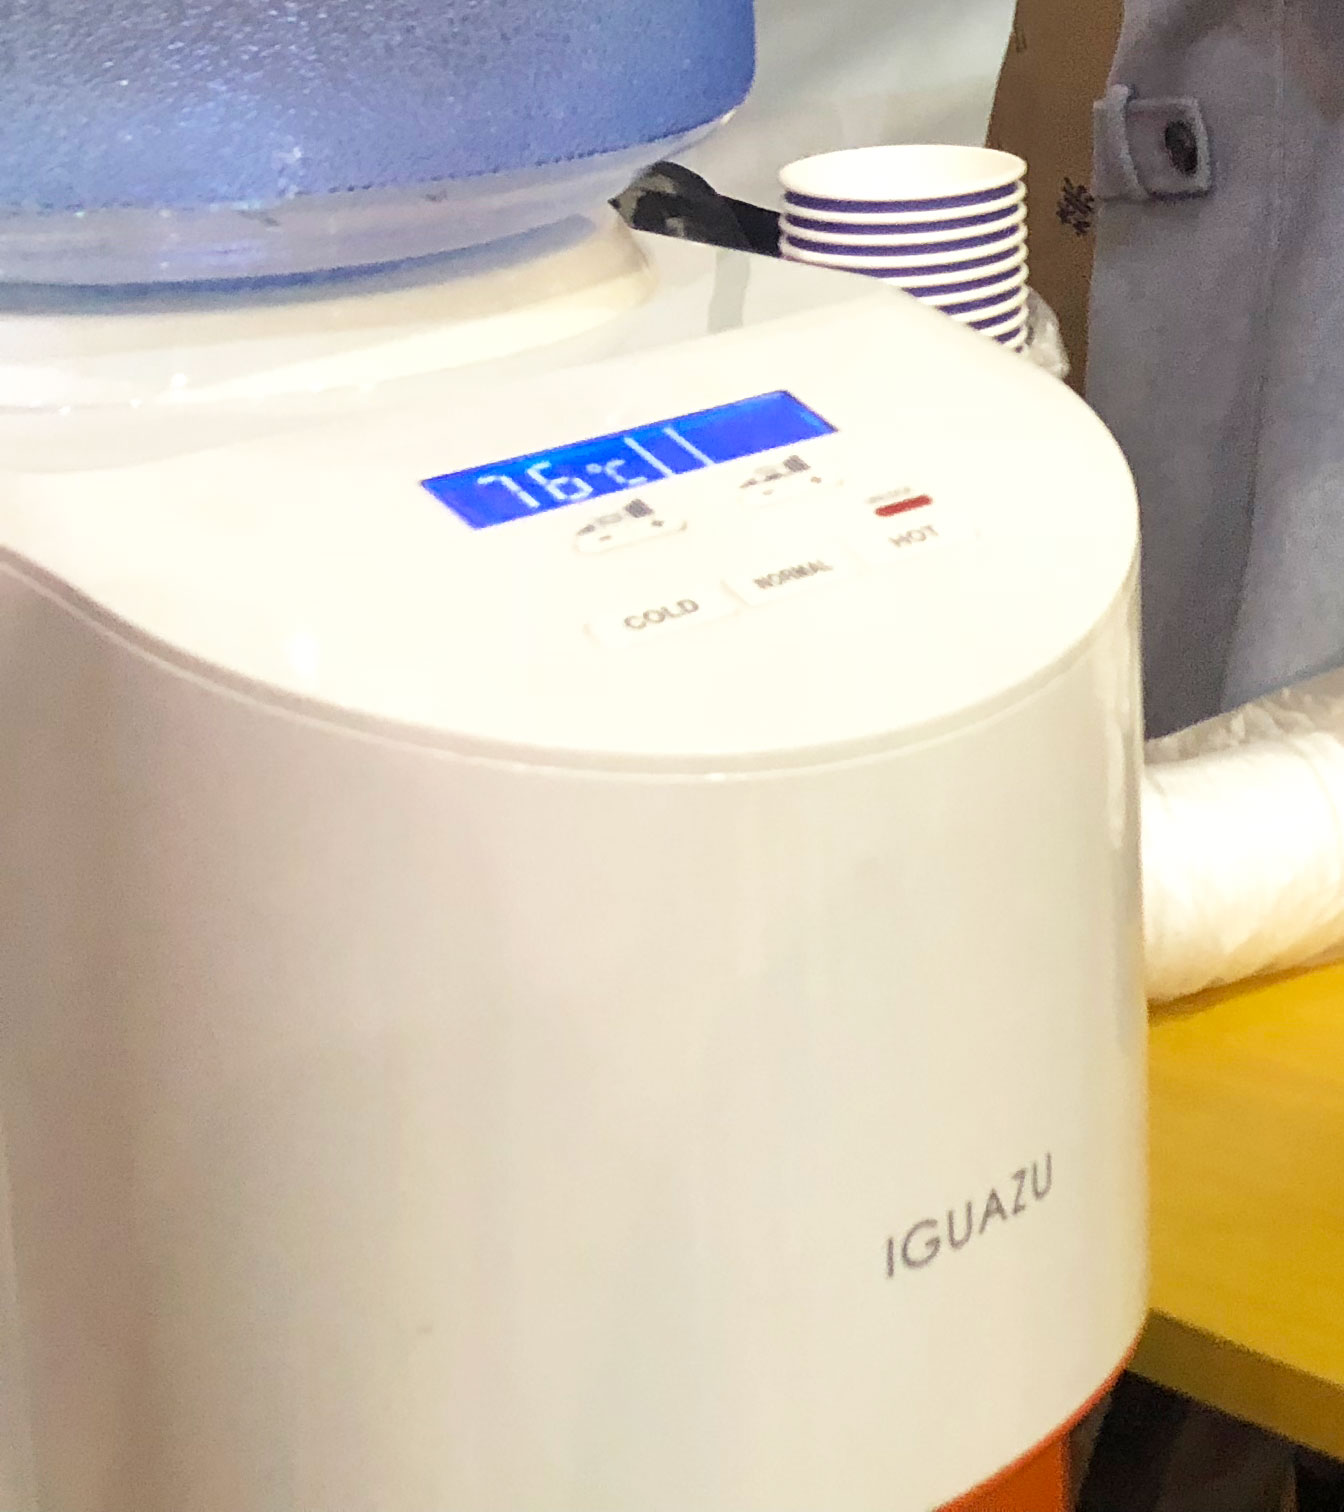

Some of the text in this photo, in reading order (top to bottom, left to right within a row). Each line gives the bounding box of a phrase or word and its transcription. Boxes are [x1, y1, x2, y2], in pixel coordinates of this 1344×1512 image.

[888, 524, 939, 548] HOT
[753, 560, 833, 589] NORMAL
[623, 599, 699, 630] COLD
[885, 1152, 1053, 1278] IGUAZU
